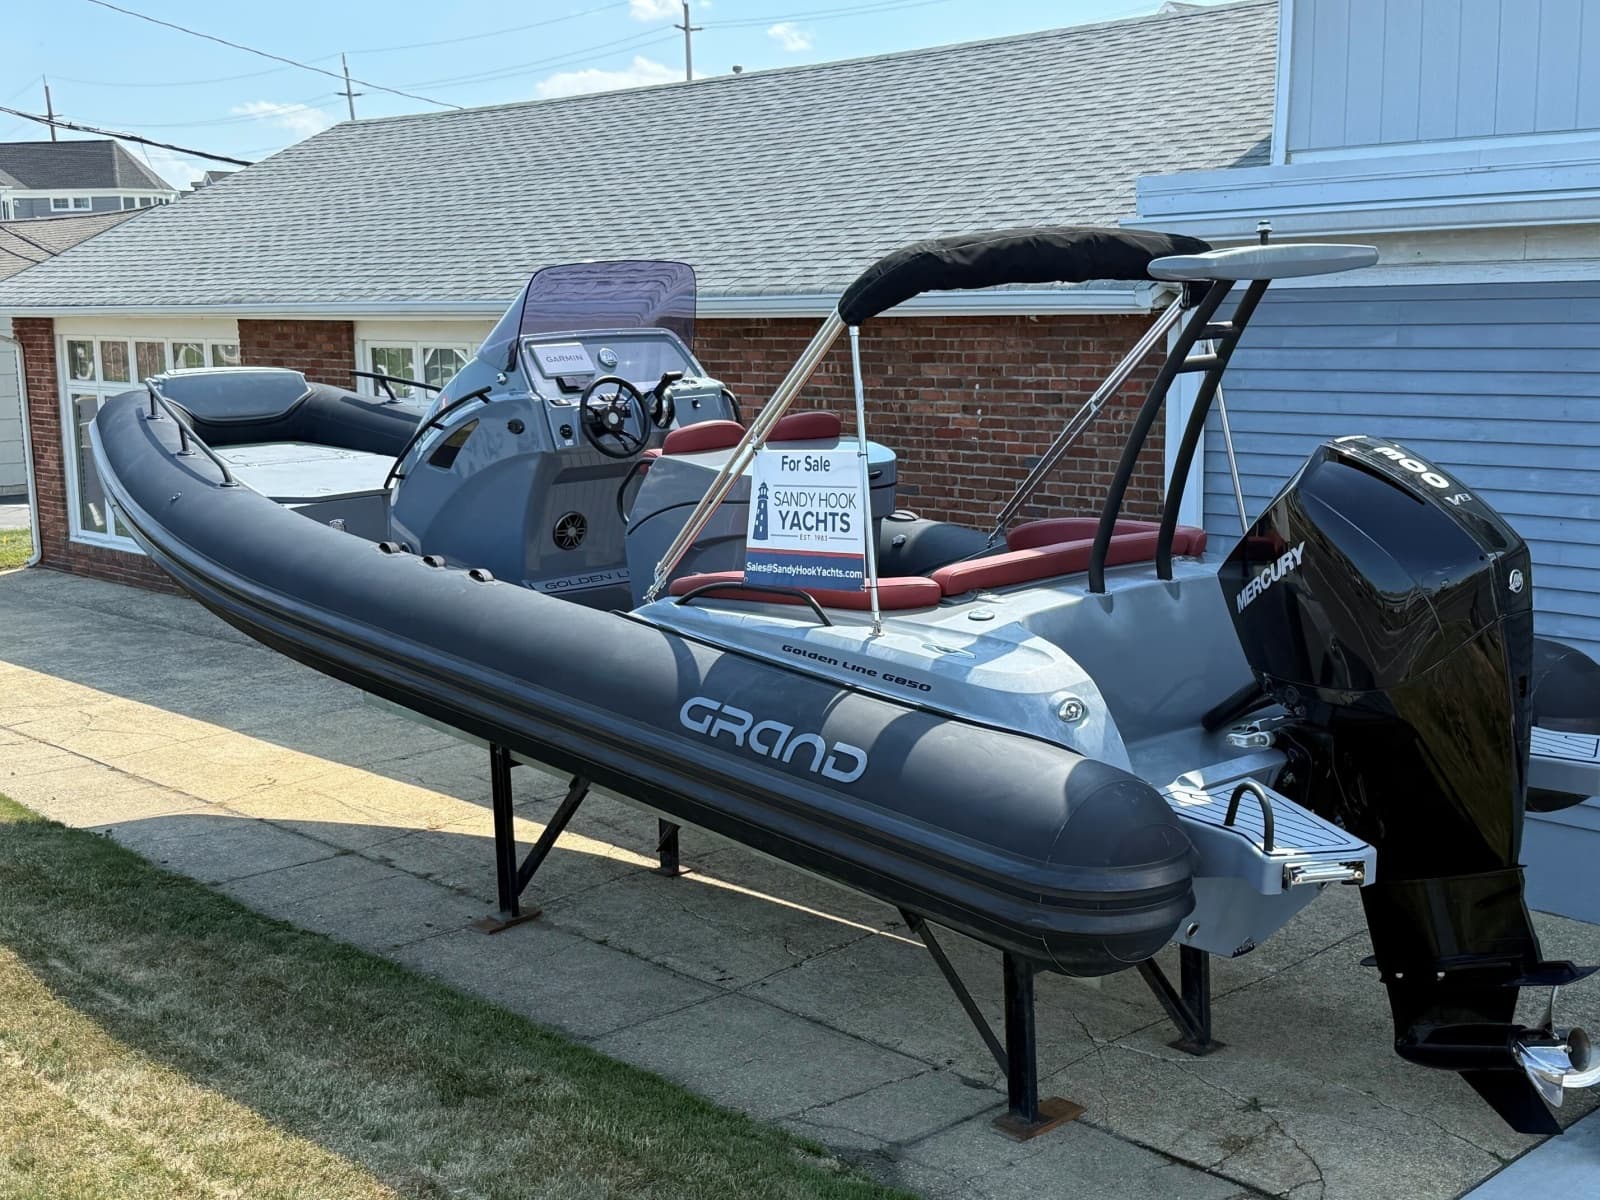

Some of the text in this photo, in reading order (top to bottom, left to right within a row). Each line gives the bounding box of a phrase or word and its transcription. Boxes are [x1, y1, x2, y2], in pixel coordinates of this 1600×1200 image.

[545, 353, 584, 363] GARMIN
[781, 455, 831, 472] For Sale
[1373, 446, 1450, 489] 300
[774, 491, 857, 510] SANDY HOOK
[778, 510, 851, 533] YACHTS
[746, 562, 863, 578] Sales@SandyHookYachts.com
[1236, 541, 1306, 615] MERCURY
[544, 573, 612, 590] GOLDEN
[781, 644, 932, 692] Golden Line G850
[679, 696, 868, 783] GRAND
